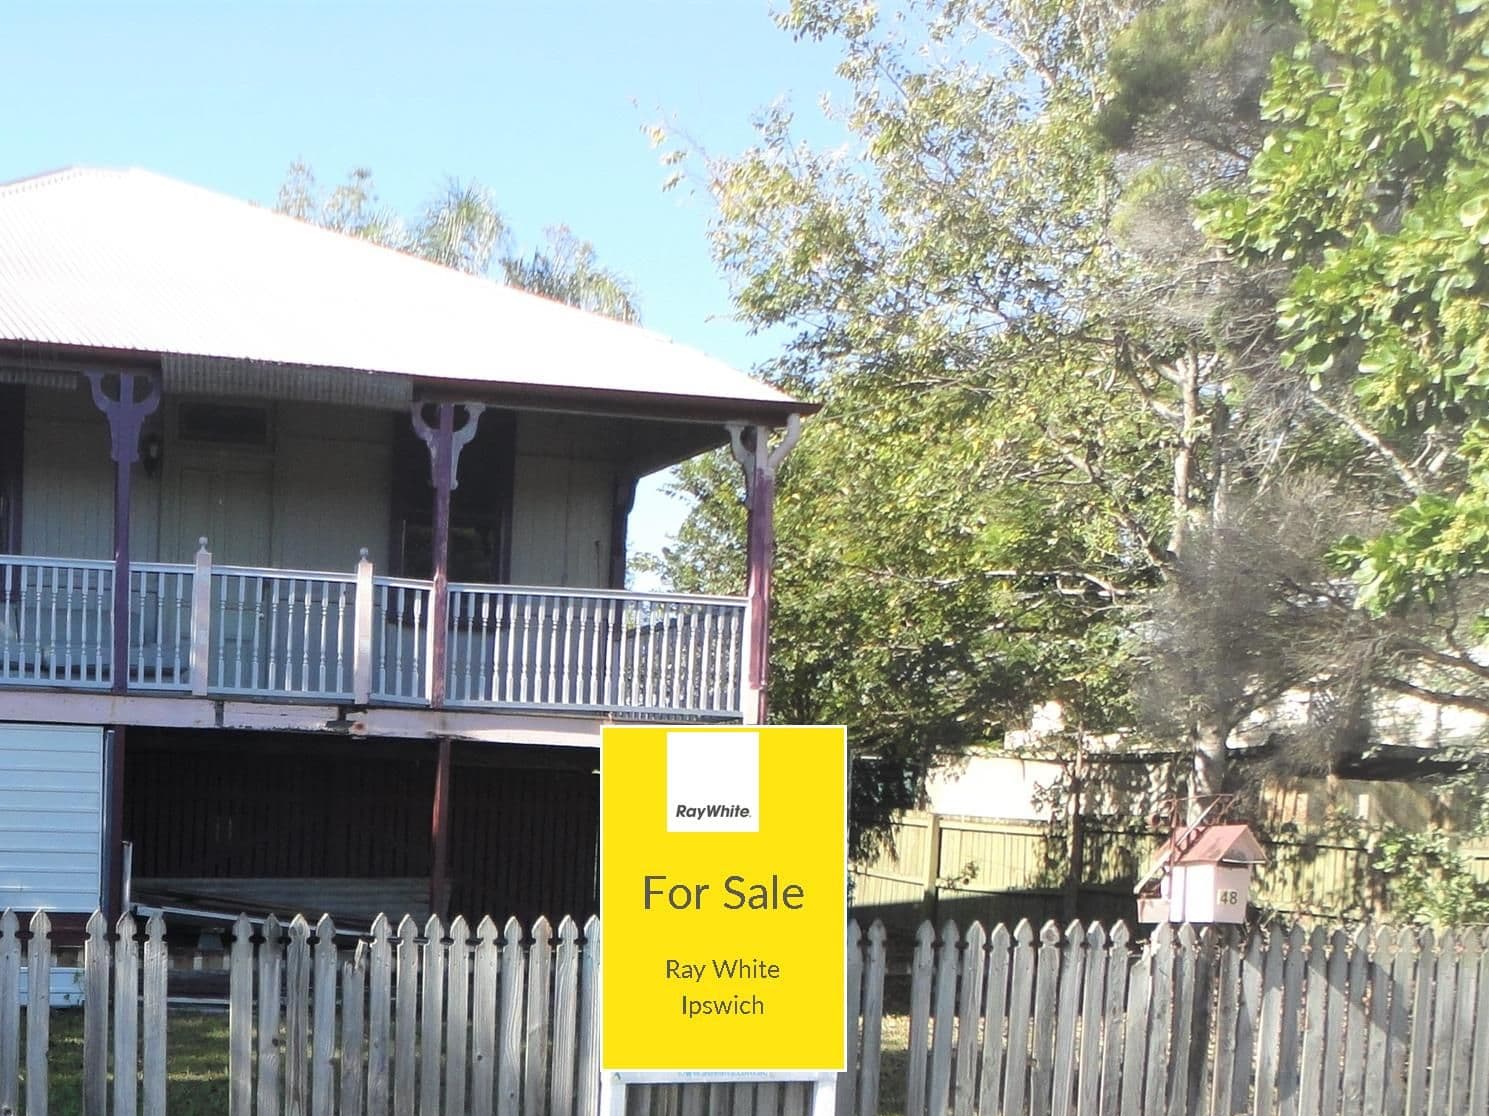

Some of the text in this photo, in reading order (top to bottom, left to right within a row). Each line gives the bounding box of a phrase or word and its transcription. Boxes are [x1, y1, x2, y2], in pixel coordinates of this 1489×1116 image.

[644, 874, 805, 910] For Sale
[1220, 891, 1238, 905] 48
[666, 958, 780, 983] Ray White
[682, 994, 764, 1019] Ipswich
